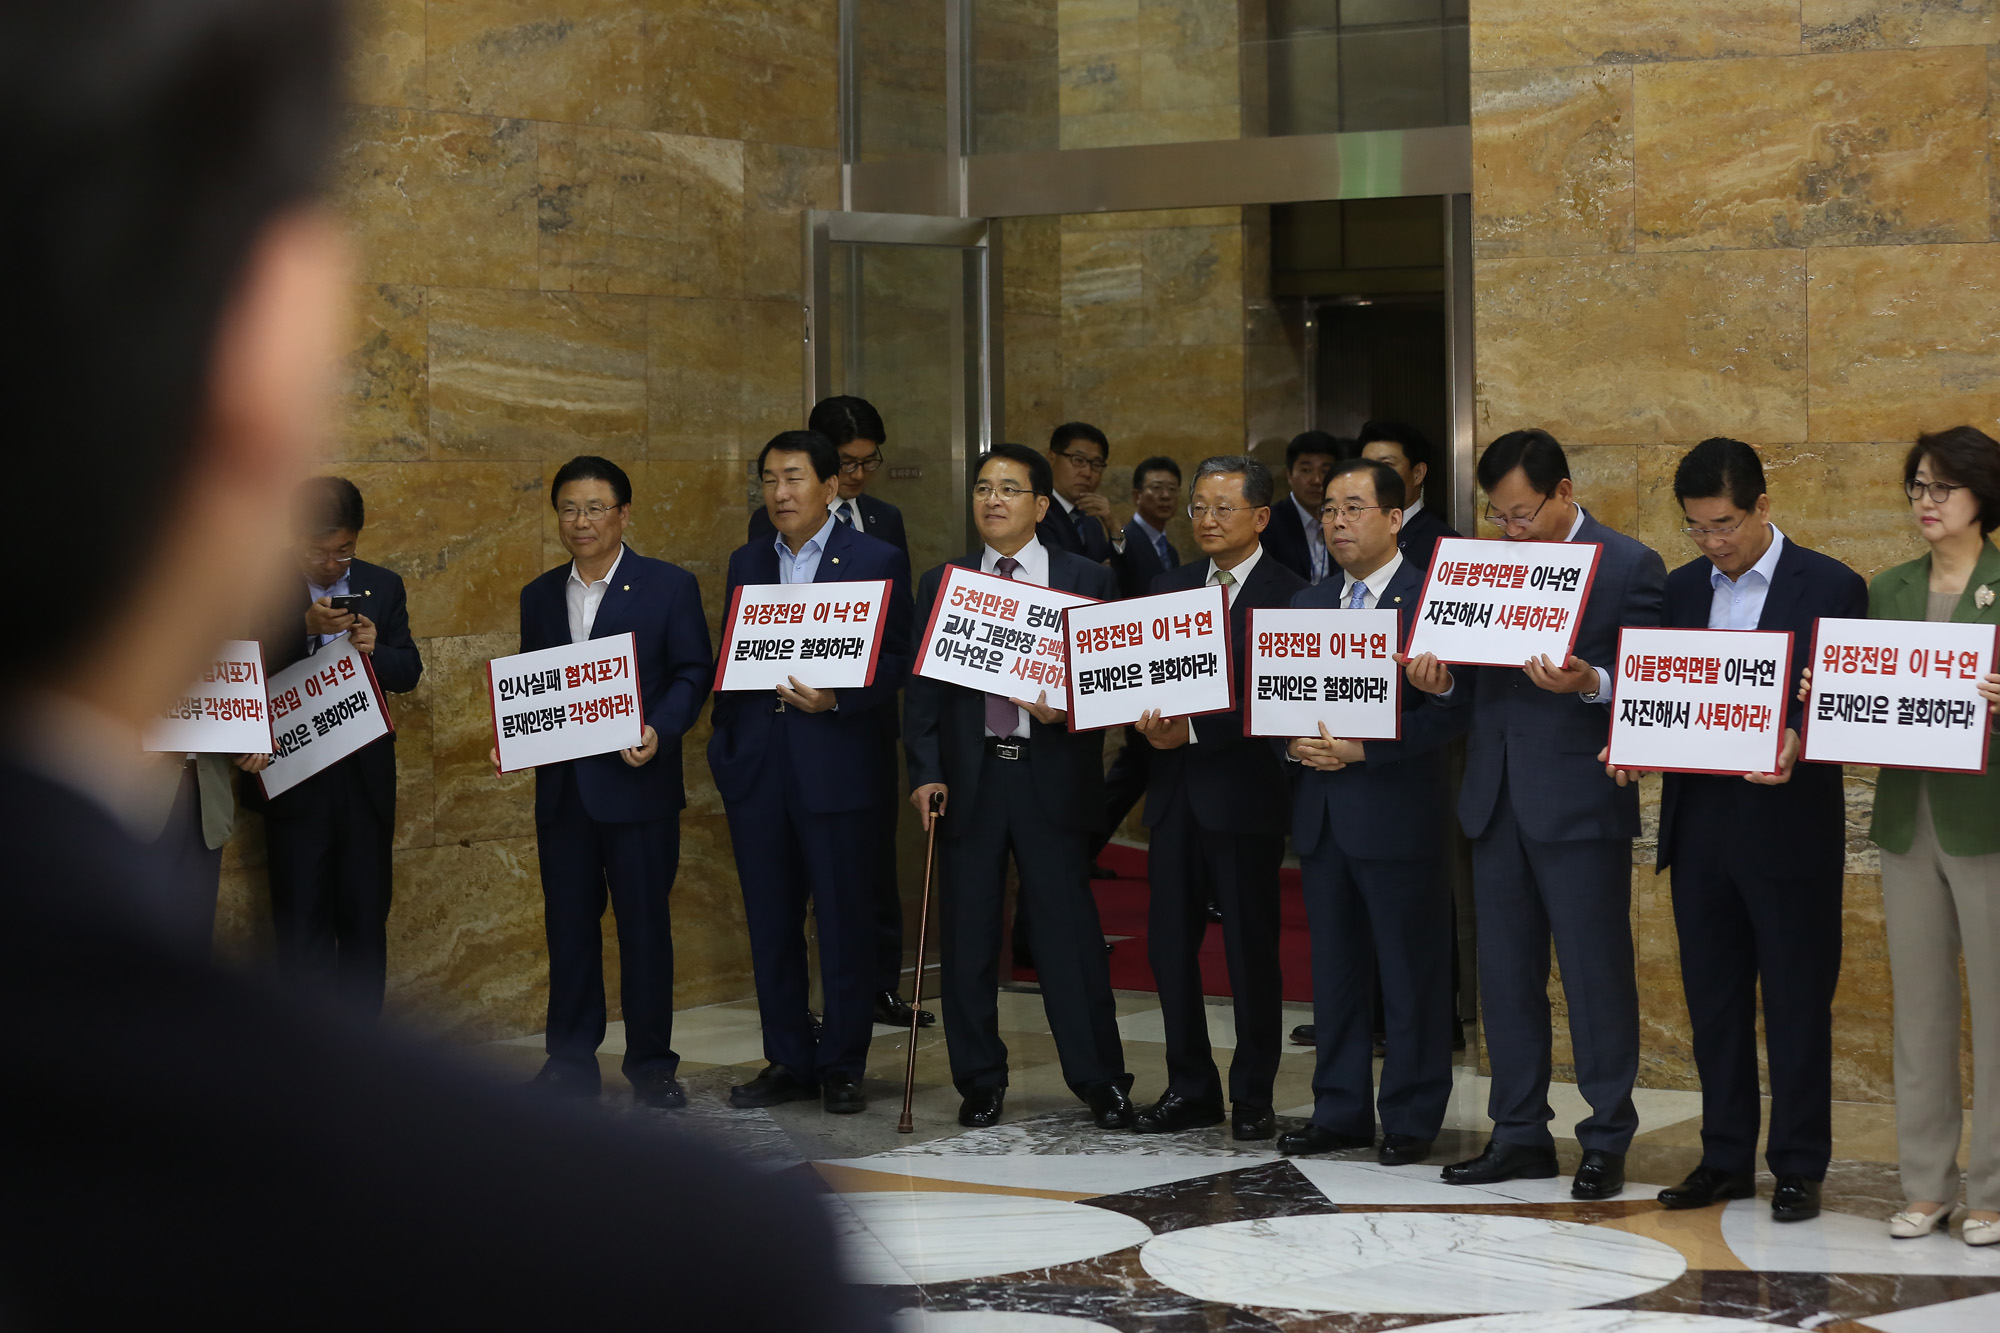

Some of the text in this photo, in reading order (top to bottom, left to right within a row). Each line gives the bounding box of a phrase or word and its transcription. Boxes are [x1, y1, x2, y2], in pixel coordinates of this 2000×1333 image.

[1437, 561, 1582, 592] 아들병역면탈 이낙연
[742, 601, 870, 625] 위장전입 이낙연
[950, 585, 1063, 633] 5천만원 당비
[1424, 600, 1570, 633] 자진해서 사퇴하라!
[734, 637, 865, 661] 문재인은 철회하라!
[942, 613, 1065, 663] 교사 그림한장 5백
[1076, 610, 1213, 654] 위장전입 이낙연
[1258, 632, 1387, 659] 위장전입 이낙연
[498, 656, 629, 701] 인사실패 협치포기
[935, 637, 1066, 689] 이낙연은 사퇴하
[1079, 652, 1218, 695] 문재인은 철회하라!
[1625, 654, 1776, 687] 아들병역면탈 이낙연
[1822, 644, 1979, 680] 위장전입 이낙연
[1257, 675, 1388, 703] 문재인은 철회하라!
[204, 698, 263, 721] 각성하라!
[502, 693, 634, 738] 문재인정부 각성하라!
[1620, 699, 1772, 733] 자진해서 사퇴하라!
[1817, 692, 1976, 730] 문재인은 철회하라!
[267, 690, 370, 767] 재인은 철회하라!
